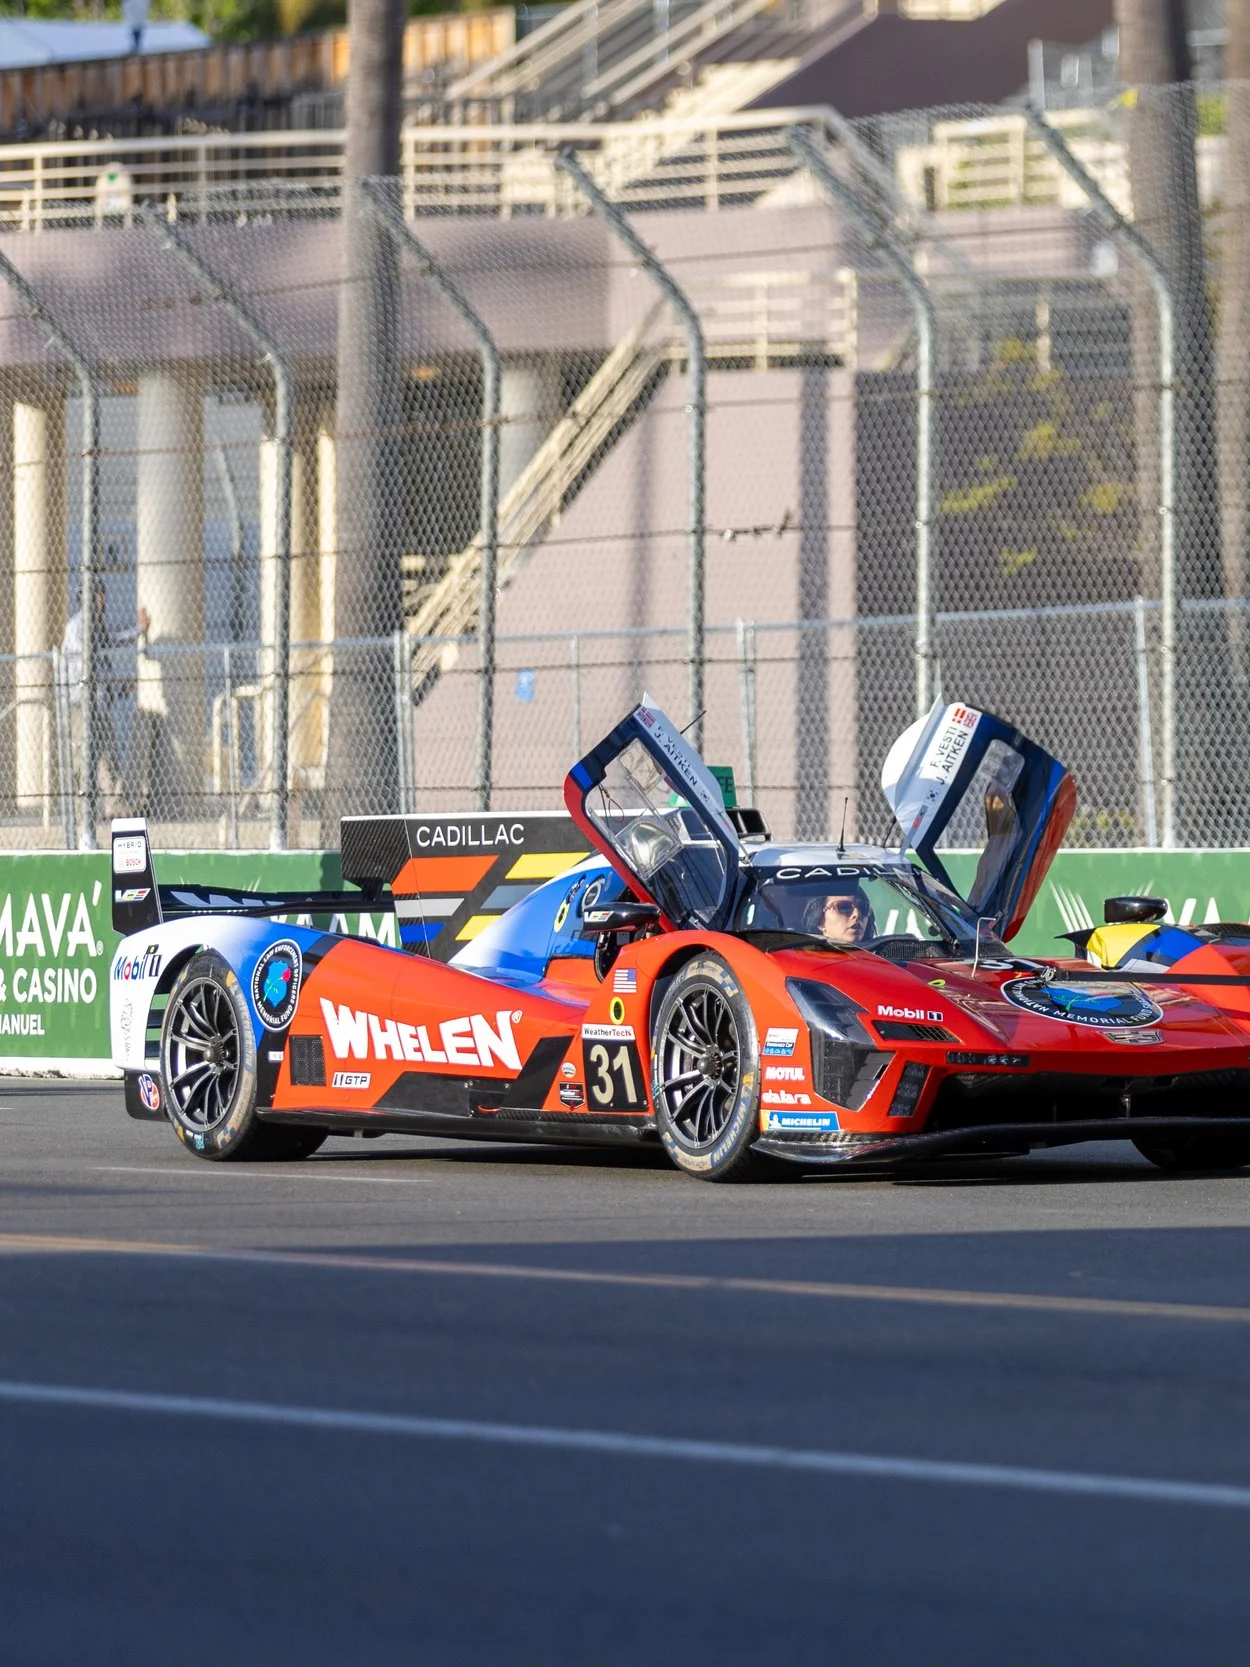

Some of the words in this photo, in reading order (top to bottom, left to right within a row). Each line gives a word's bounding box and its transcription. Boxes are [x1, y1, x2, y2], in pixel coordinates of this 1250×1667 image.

[935, 726, 957, 757] VESTI
[941, 730, 969, 773] AITKEN
[663, 743, 698, 786] AITKEN
[416, 823, 525, 847] CADILLAC
[0, 879, 103, 958] AVA'
[114, 953, 148, 981] Mobil
[254, 963, 265, 1001] NATIONAL
[263, 949, 275, 961] LAW
[274, 944, 299, 967] ENFORCEMENT
[13, 967, 97, 1003] CASINO
[0, 1014, 45, 1035] ANUEL
[257, 1000, 281, 1024] MEMORIAL
[280, 1004, 293, 1023] FUND
[877, 1004, 924, 1020] Mobil
[1053, 1009, 1132, 1024] MEMORIAL
[319, 996, 523, 1071] WHELEN
[584, 1027, 632, 1037] WeatherTech
[345, 1075, 368, 1085] GTP
[590, 1044, 637, 1104] 31
[764, 1067, 806, 1080] MOTUL
[713, 1102, 747, 1162] MICHELIN
[781, 1118, 831, 1127] MICHELIN
